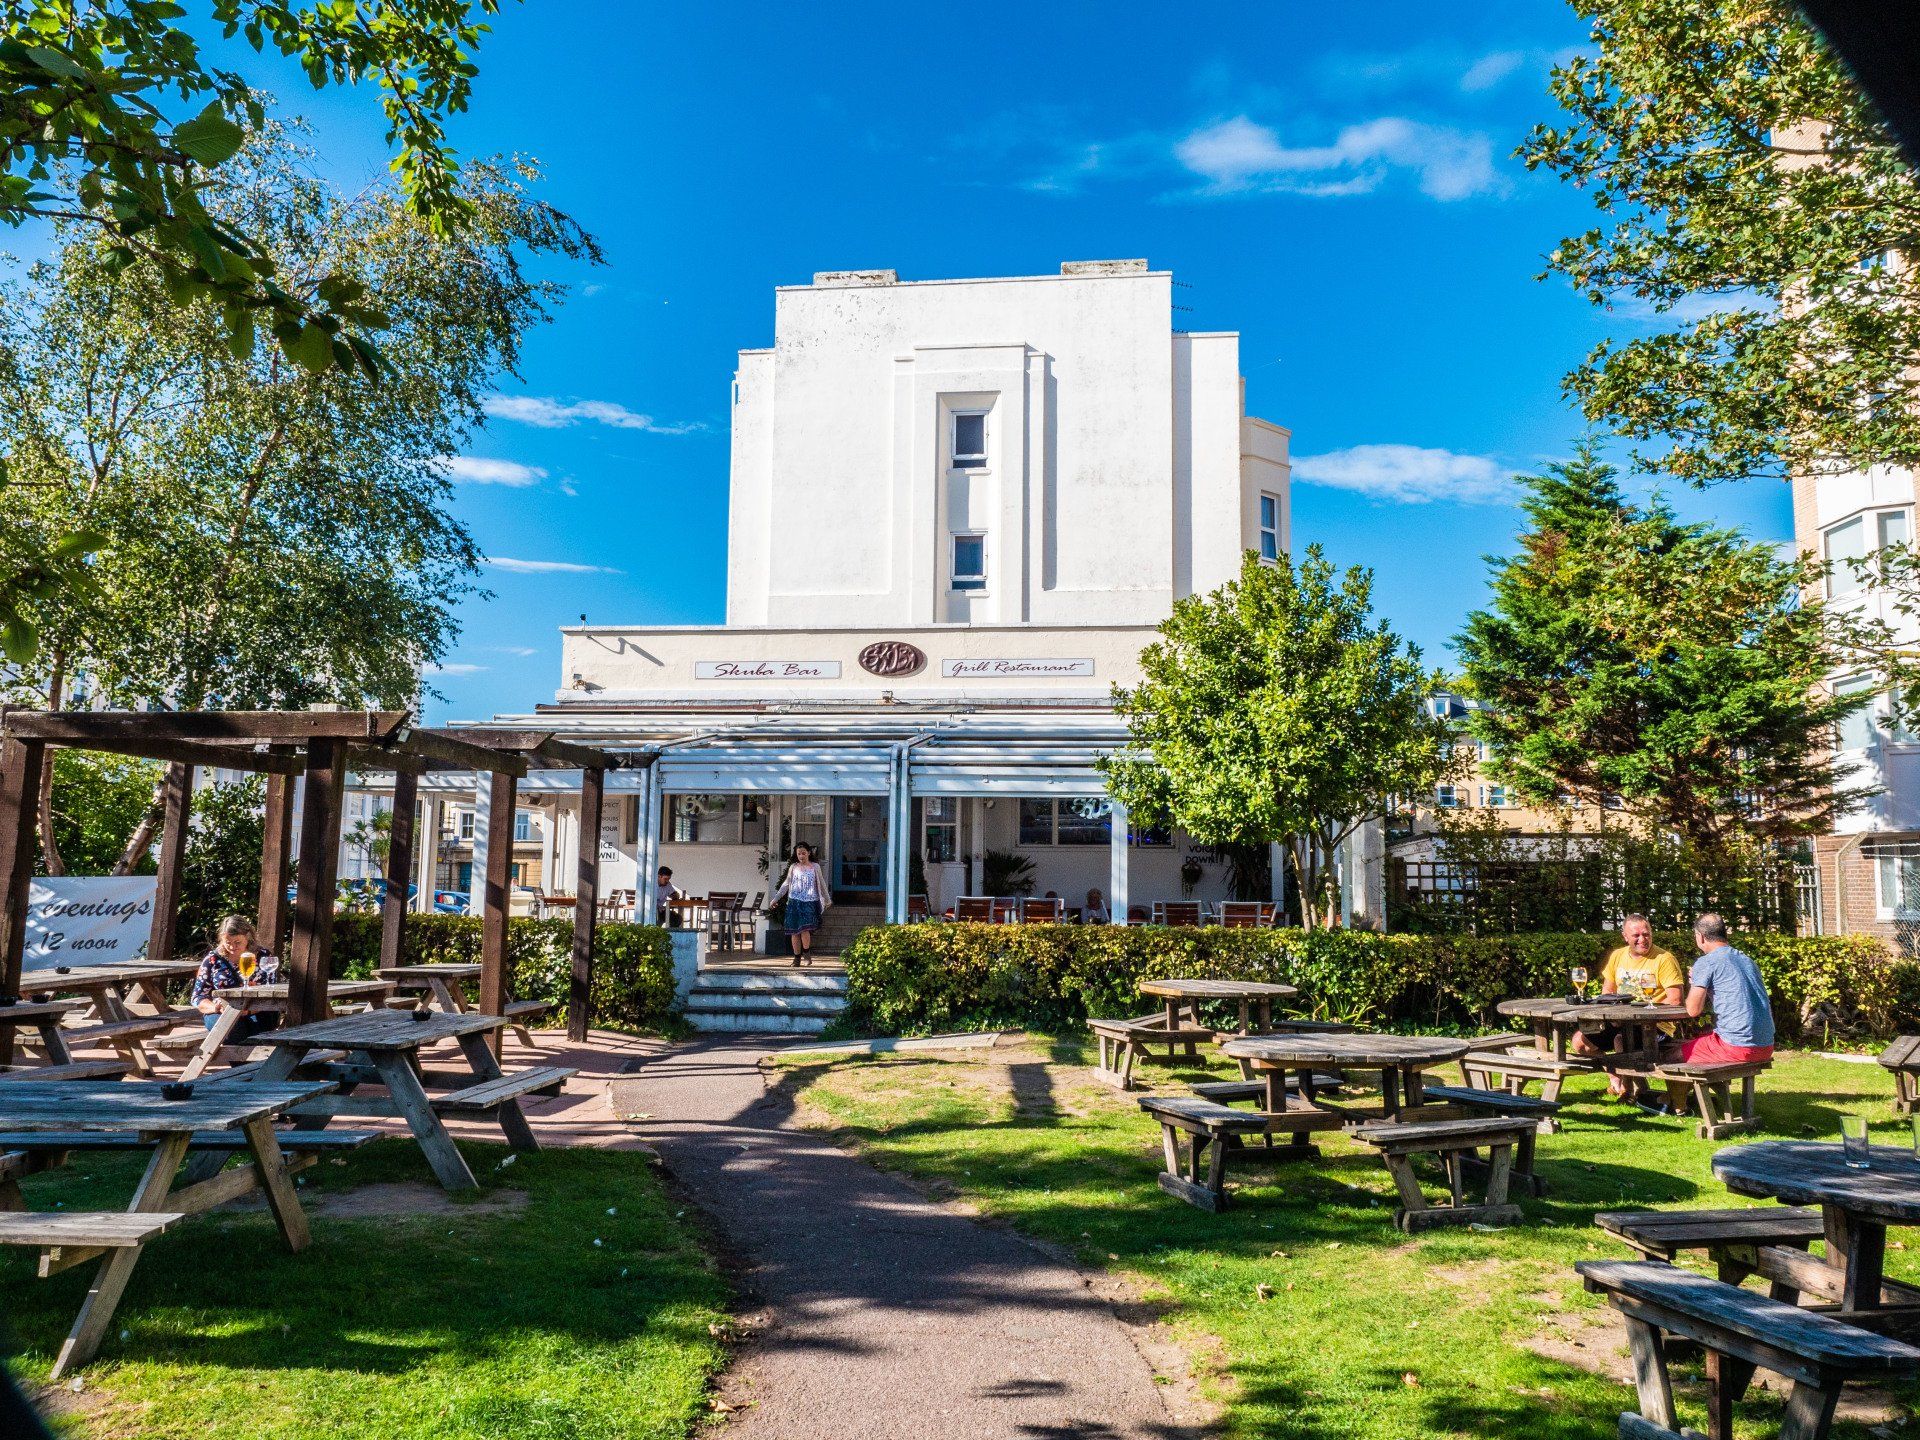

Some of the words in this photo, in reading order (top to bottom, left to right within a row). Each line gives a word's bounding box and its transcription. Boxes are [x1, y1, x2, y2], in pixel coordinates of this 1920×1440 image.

[714, 662, 776, 678] Skuba
[782, 663, 822, 676] Bar
[951, 661, 989, 677] Grill
[994, 660, 1085, 674] Restaurant
[42, 897, 152, 923] evenings
[40, 932, 65, 951] 12
[71, 938, 118, 950] noon
